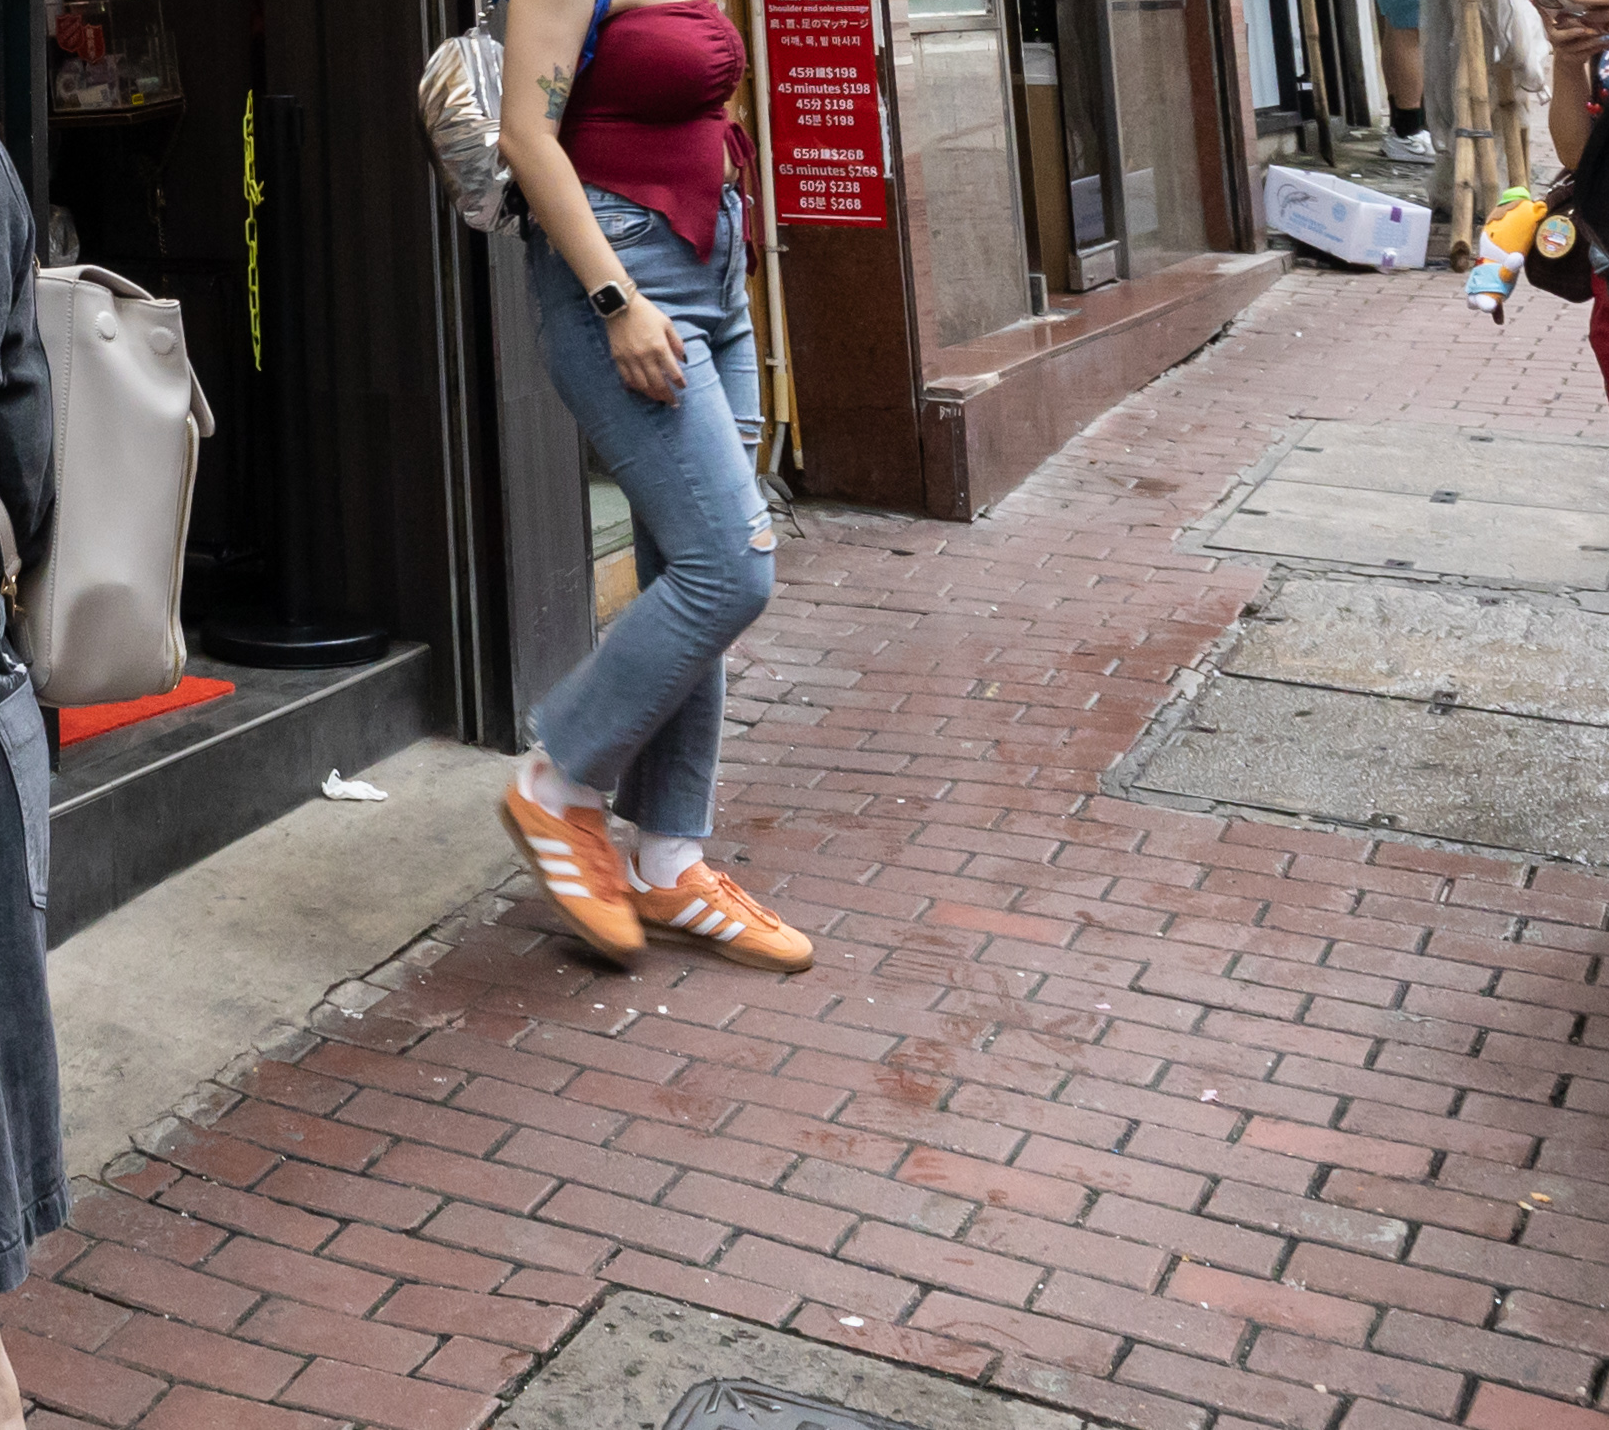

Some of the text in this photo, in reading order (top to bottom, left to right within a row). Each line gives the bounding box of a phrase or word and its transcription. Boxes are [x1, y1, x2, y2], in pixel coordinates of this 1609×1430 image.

[778, 83, 871, 95] 45 minutes $198
[796, 99, 854, 111] 45分 $198
[825, 114, 855, 126] $198
[779, 164, 878, 178] 65 minutes $268
[829, 181, 861, 193] $238
[830, 197, 862, 210] $268
